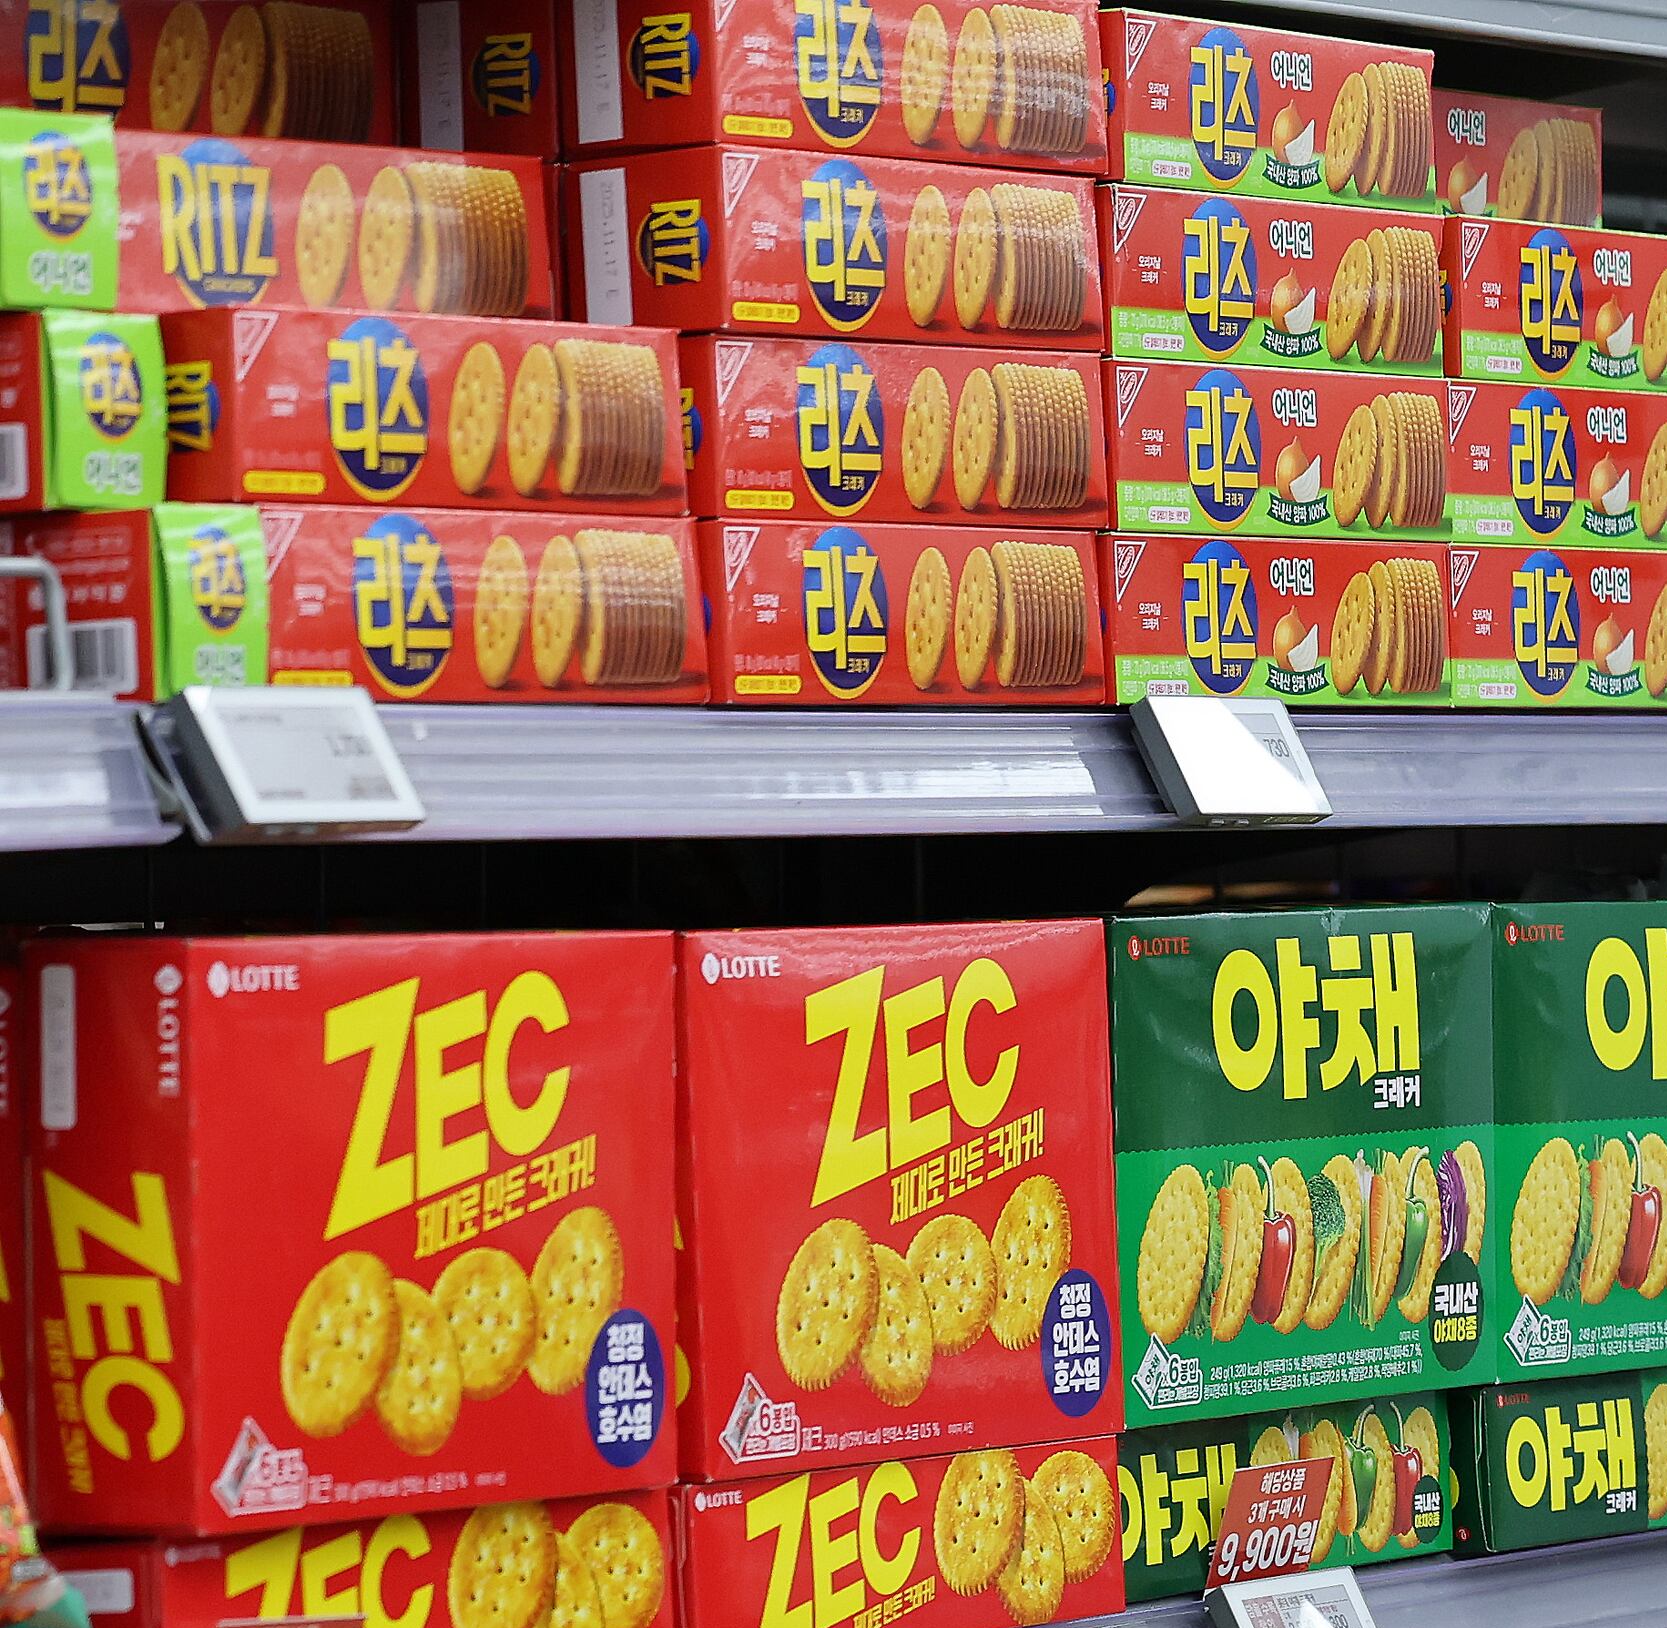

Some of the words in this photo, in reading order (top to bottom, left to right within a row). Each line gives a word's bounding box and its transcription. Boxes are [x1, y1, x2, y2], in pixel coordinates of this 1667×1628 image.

[643, 12, 692, 99] RITZ
[796, 0, 882, 117] 리츠
[1271, 51, 1313, 92] 어니언
[1190, 45, 1256, 161] 리츠
[28, 142, 91, 228] 리츠
[156, 154, 278, 283] RITZ
[651, 199, 701, 286] RITZ
[801, 178, 886, 301] 리츠
[1184, 216, 1255, 332] 리츠
[1269, 219, 1313, 260] 어니언
[1593, 248, 1632, 287] 어니언
[1521, 245, 1580, 355] 리츠
[167, 360, 213, 452] RITZ
[328, 336, 428, 471] 리츠
[796, 363, 882, 487] 리츠
[1186, 387, 1258, 503] 리츠
[1273, 387, 1318, 427] 어니언
[1587, 406, 1627, 443] 어니언
[1510, 406, 1574, 515] 리츠
[354, 533, 453, 667] 리츠
[803, 545, 887, 670] 리츠
[1183, 558, 1256, 674] 리츠
[1270, 557, 1315, 596] 어니언
[1590, 566, 1632, 604] 어니언
[1512, 568, 1578, 678] 리츠
[722, 955, 781, 981] LOTTE
[1143, 936, 1190, 958] LOTTE
[1519, 922, 1566, 944] LOTTE
[231, 965, 299, 993] LOTTE
[1213, 931, 1421, 1100] 야채
[323, 970, 571, 1241] ZEC
[805, 957, 1020, 1209] ZEC
[1372, 1077, 1422, 1110] 크래커
[891, 1161, 946, 1226] 제대로
[948, 1136, 985, 1194] 만든
[987, 1108, 1045, 1177] 크래커!
[43, 1171, 185, 1462] ZEC
[1052, 1321, 1101, 1358] 안데스
[1059, 1283, 1092, 1321] 청정
[1432, 1314, 1480, 1346] 야채8종
[1433, 1281, 1480, 1320] 국내산
[1053, 1357, 1101, 1395] 호수염
[1260, 1467, 1307, 1495] 해당상품
[1505, 1398, 1637, 1513] 야채
[705, 1490, 743, 1508] LOTTE
[1118, 1443, 1236, 1566] 야채
[1247, 1500, 1268, 1525] 3개
[1413, 1492, 1441, 1513] 국내산
[1604, 1491, 1638, 1516] 크래커
[1216, 1519, 1319, 1583] 9,900원
